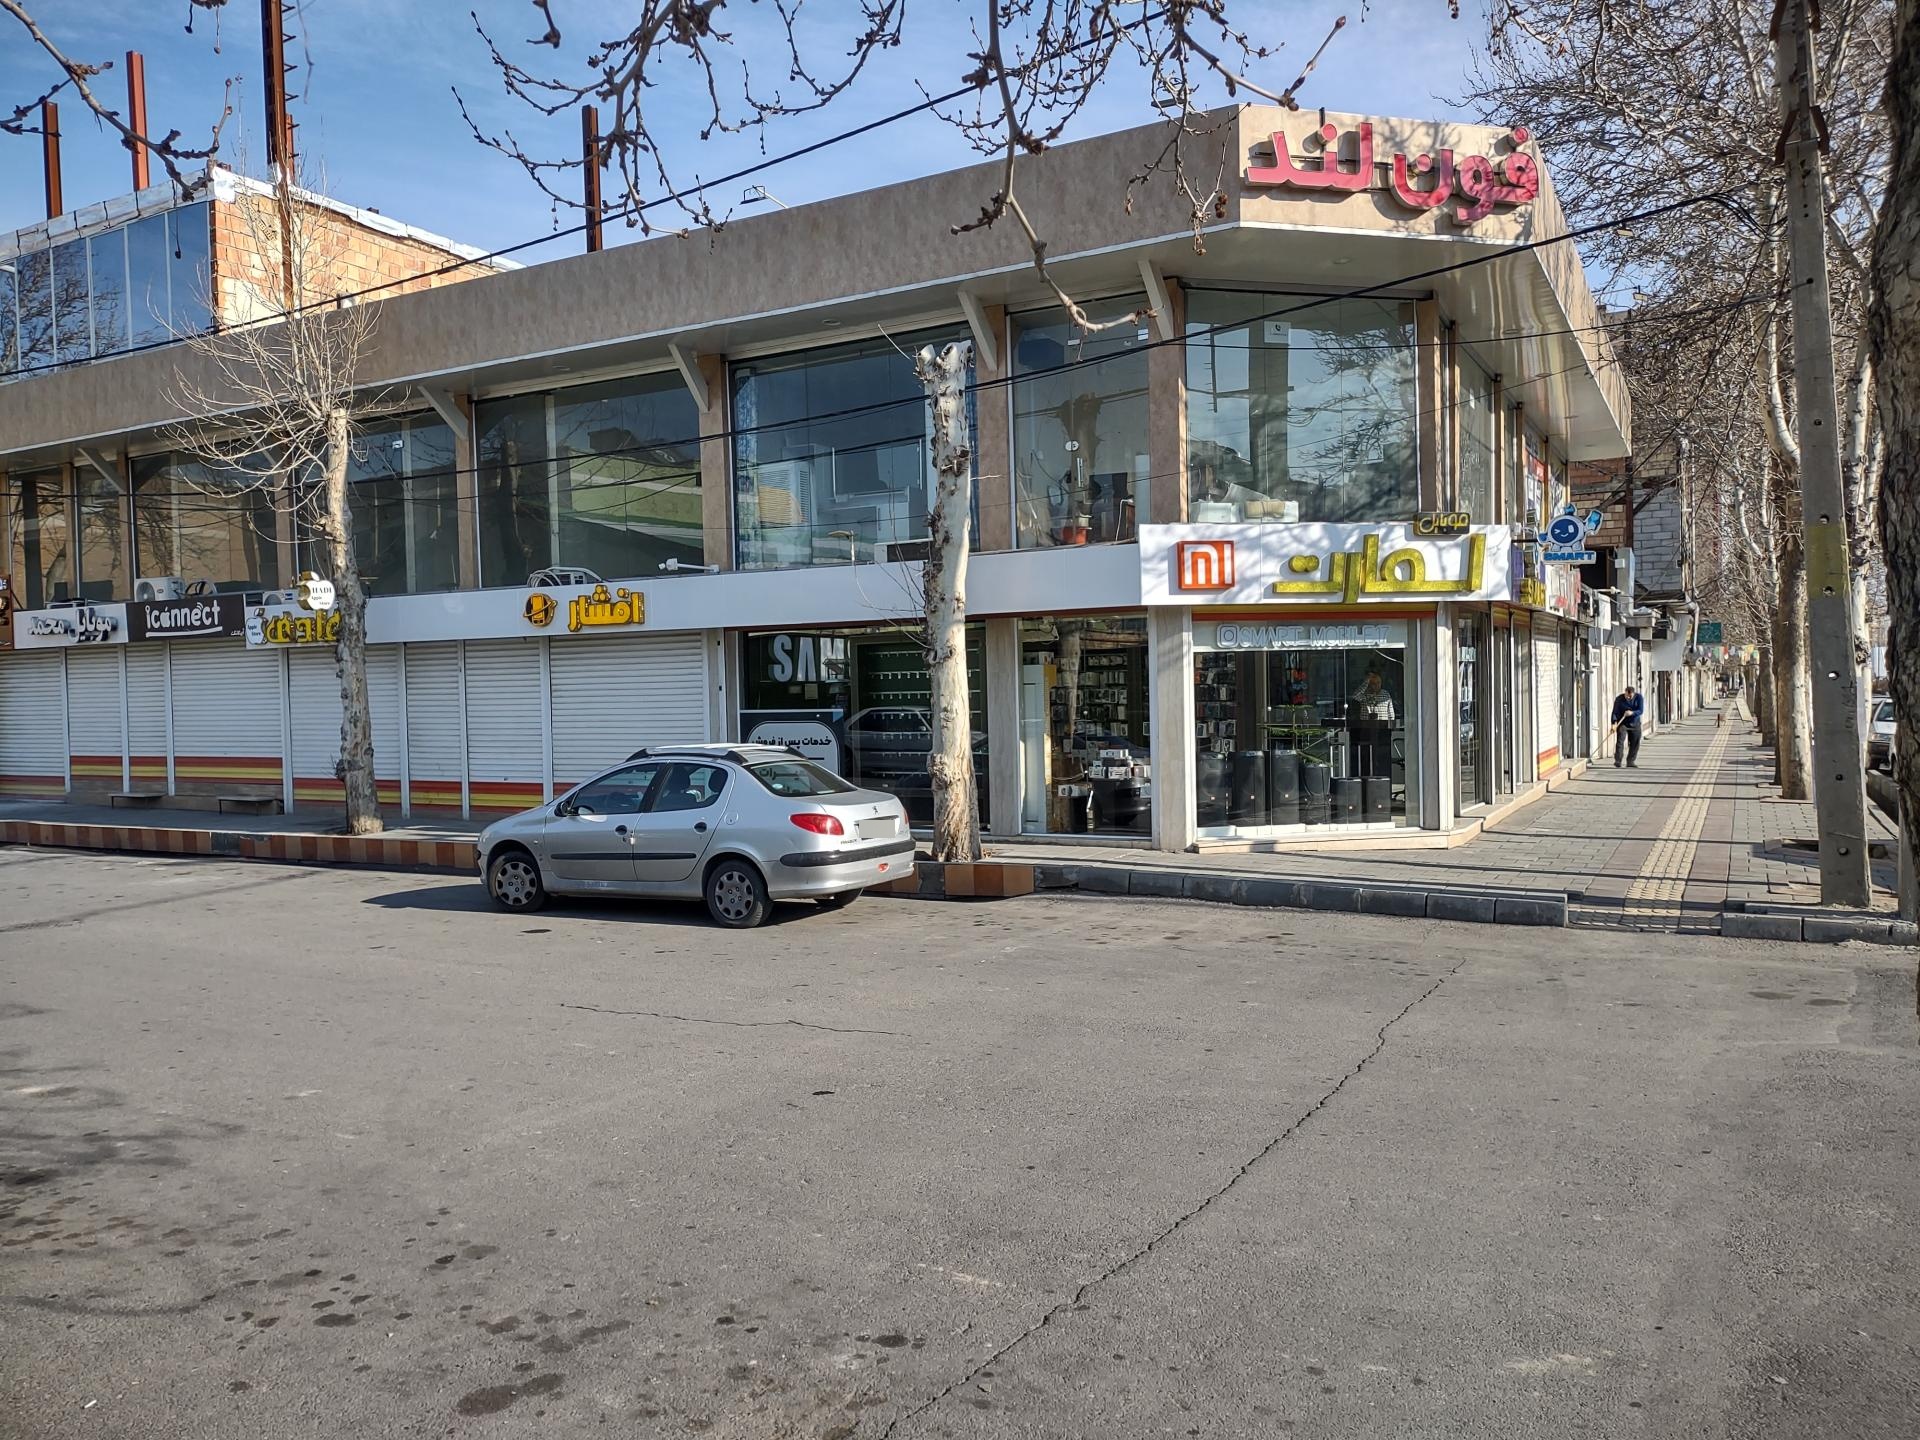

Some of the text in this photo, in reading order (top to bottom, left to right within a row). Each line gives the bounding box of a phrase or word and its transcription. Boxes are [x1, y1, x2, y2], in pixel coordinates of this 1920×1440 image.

[1247, 122, 1539, 222] فون لند
[1419, 513, 1469, 534] موبایل
[1543, 551, 1594, 562] SMART
[567, 584, 645, 632] افشار
[27, 608, 115, 643] موبایل محمد
[785, 737, 801, 750] پس
[802, 735, 832, 746] خدمات
